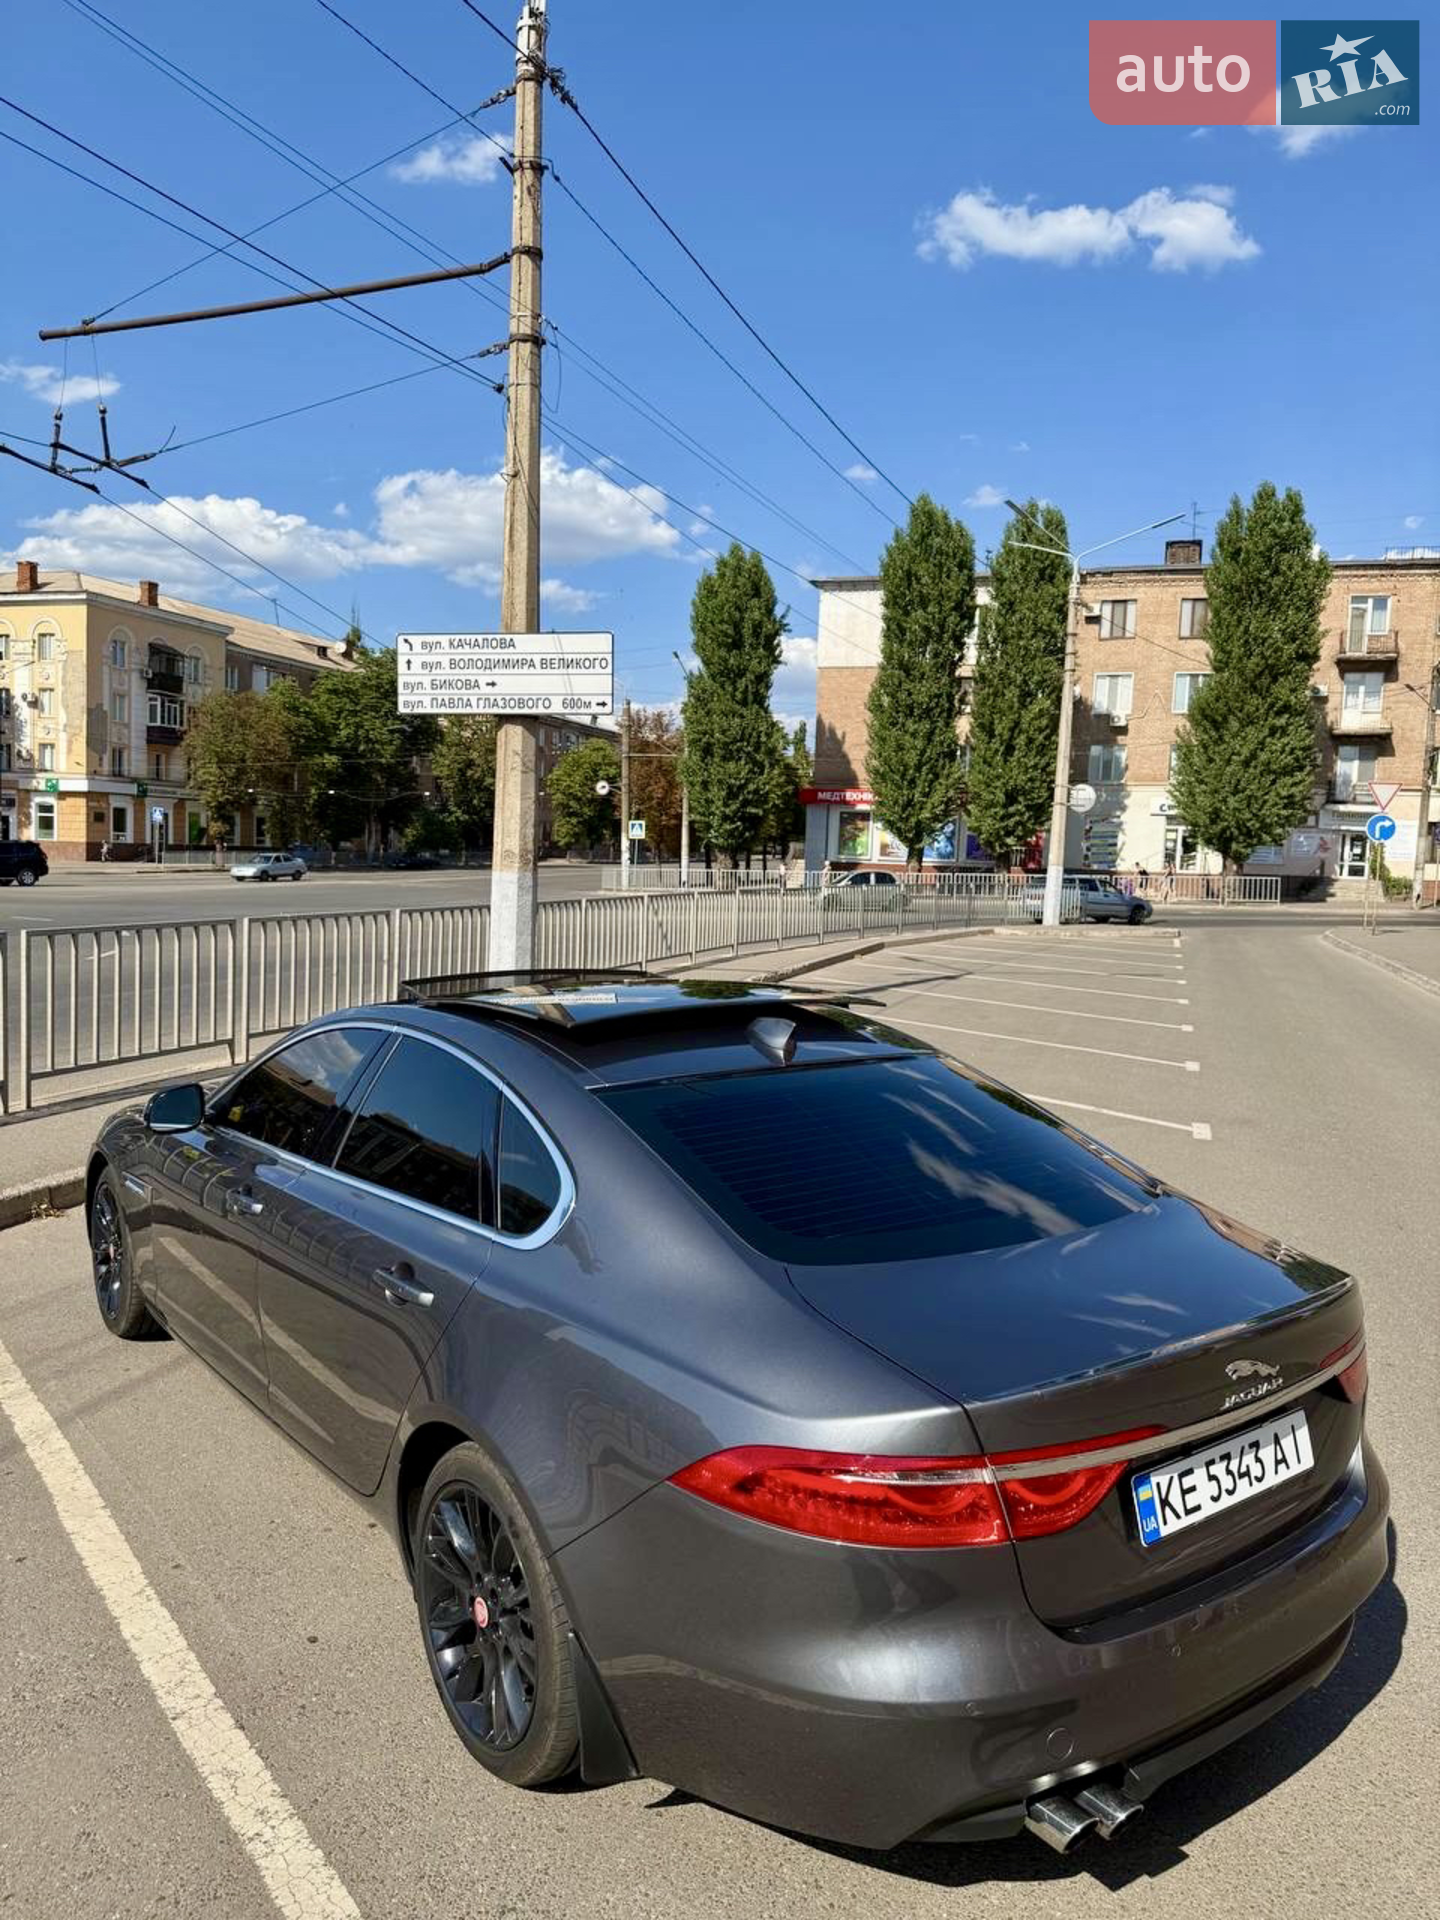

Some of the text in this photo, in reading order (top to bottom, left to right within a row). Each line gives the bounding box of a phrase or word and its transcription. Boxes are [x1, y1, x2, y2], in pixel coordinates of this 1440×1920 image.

[421, 637, 516, 651] вул. КАЧАЛОВА
[421, 657, 609, 672] вул. ВОЛОДИМИРА ВЕЛИКОГО
[402, 678, 481, 692] вул. БИКОВА
[402, 697, 592, 711] вул. ПАВЛА ГЛАЗОВОГО 600м
[1156, 1424, 1302, 1526] KE 5343 AI
[1142, 1517, 1159, 1533] UA
